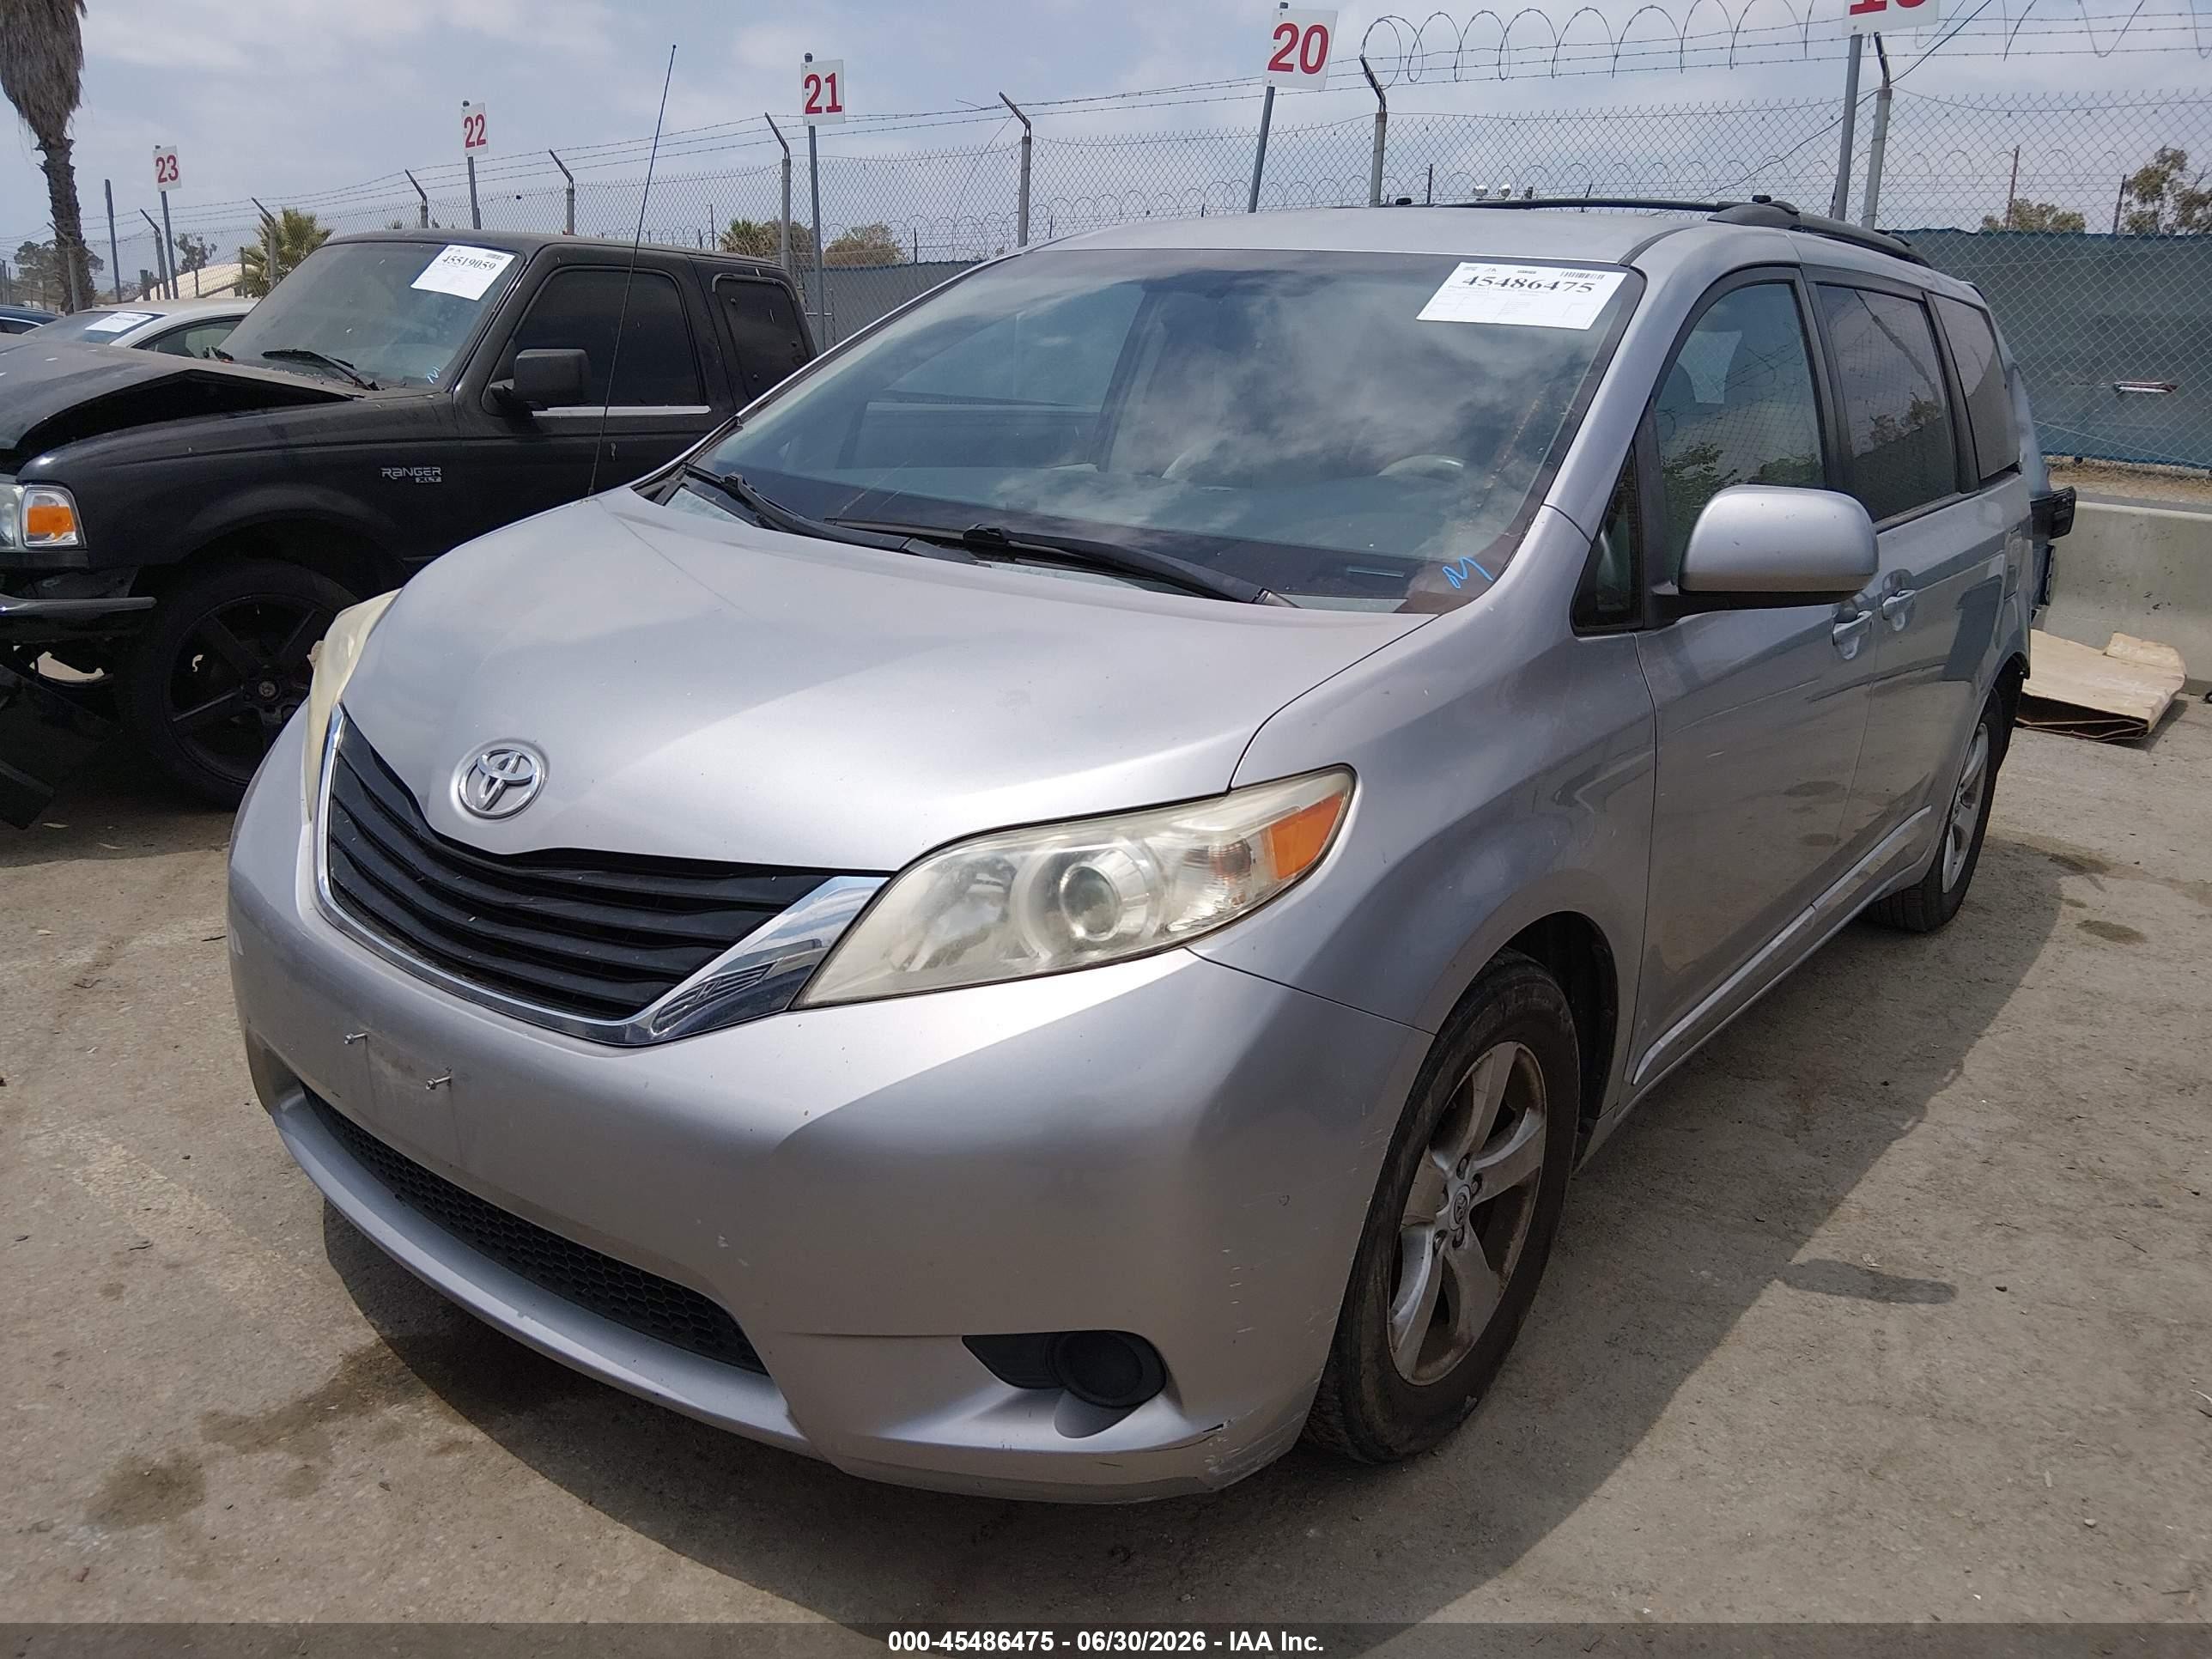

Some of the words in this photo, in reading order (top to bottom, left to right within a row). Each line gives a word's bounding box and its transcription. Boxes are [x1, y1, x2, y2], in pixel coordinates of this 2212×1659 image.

[1267, 22, 1329, 75] 20
[804, 72, 842, 114] 21
[464, 113, 487, 148] 22
[155, 155, 179, 183] 23
[441, 255, 496, 271] 45519059
[1462, 274, 1596, 294] 45486475
